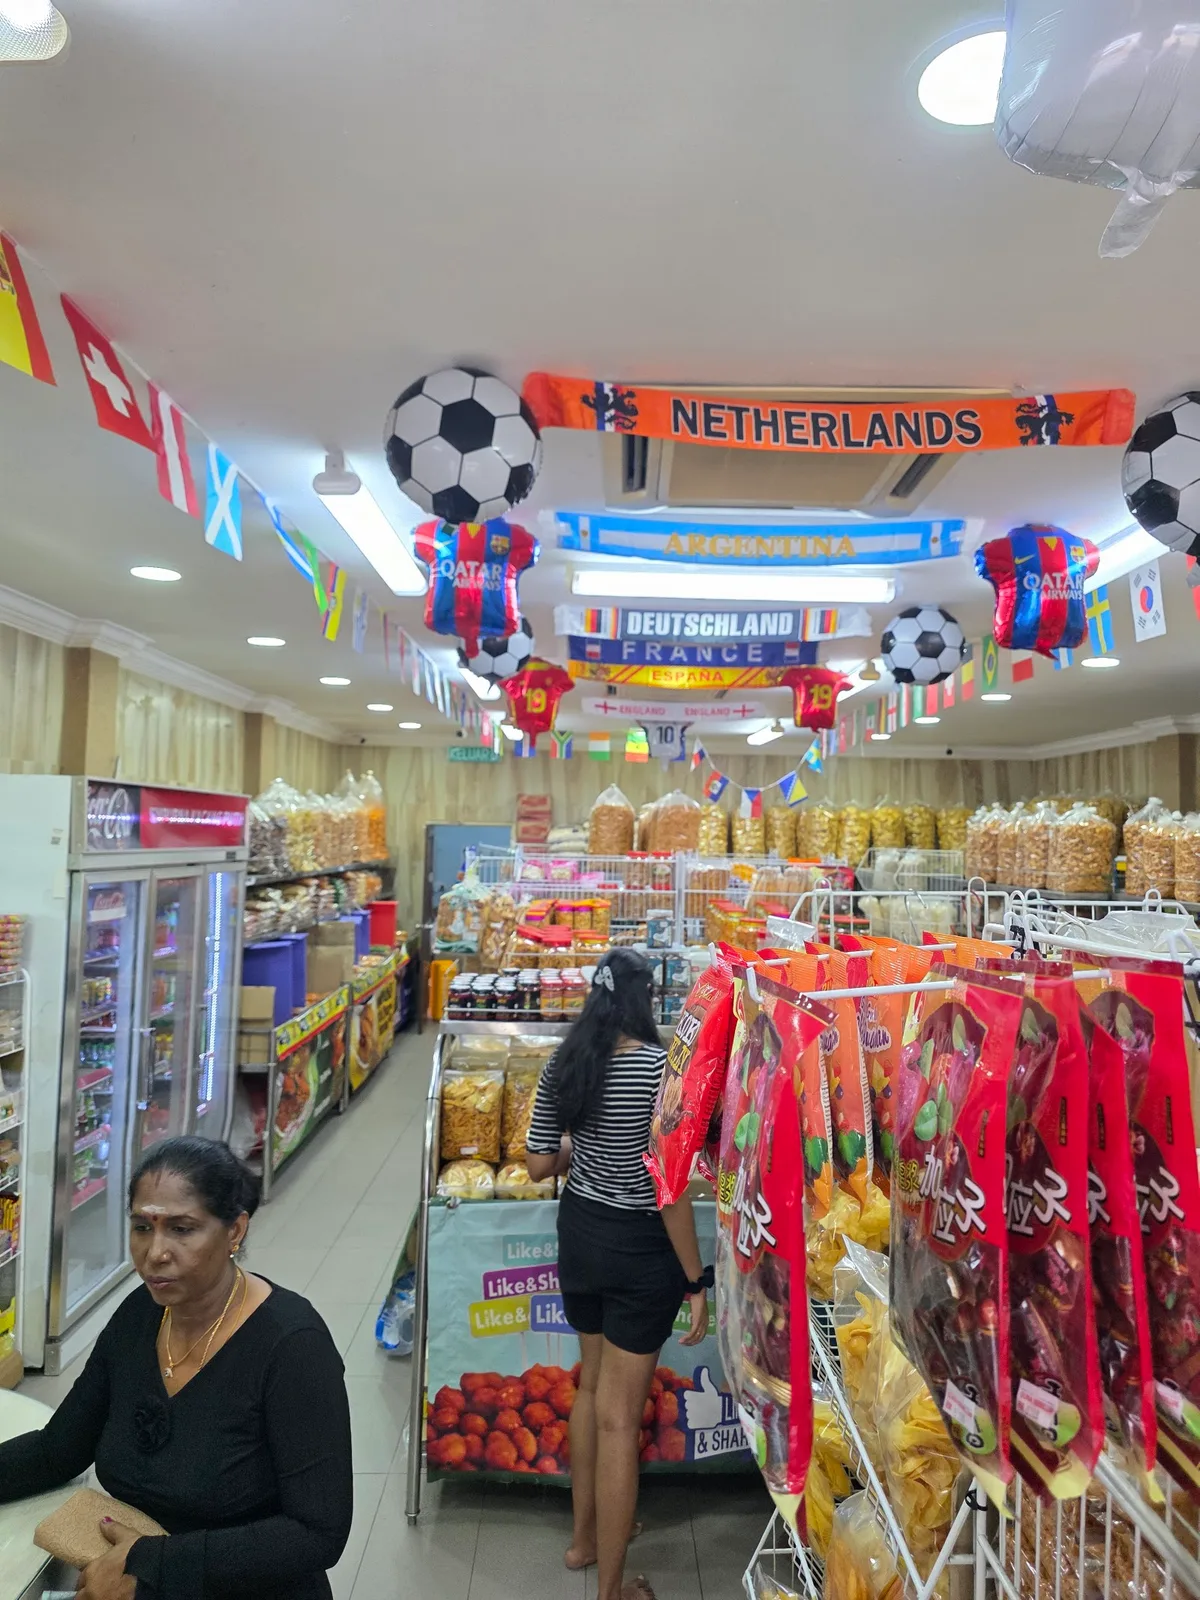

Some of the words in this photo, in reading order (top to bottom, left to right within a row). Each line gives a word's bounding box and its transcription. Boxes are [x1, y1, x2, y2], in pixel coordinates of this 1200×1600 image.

[671, 397, 983, 448] NETHERLANDS
[664, 532, 856, 558] ARGENTINA
[440, 559, 502, 580] QATAR
[1023, 572, 1083, 592] QATAR
[627, 611, 793, 636] DEUTSCHLAND
[622, 641, 763, 662] FRANCE
[652, 668, 724, 682] ESPAÑA
[525, 687, 547, 713] 19
[810, 683, 833, 710] 19
[619, 705, 666, 716] ENGLAND
[684, 707, 731, 716] ENGLAND
[656, 726, 674, 745] 10
[507, 1241, 558, 1259] Like&
[475, 1306, 530, 1330] Like&
[536, 1303, 569, 1325] Lik
[697, 1431, 708, 1454] &
